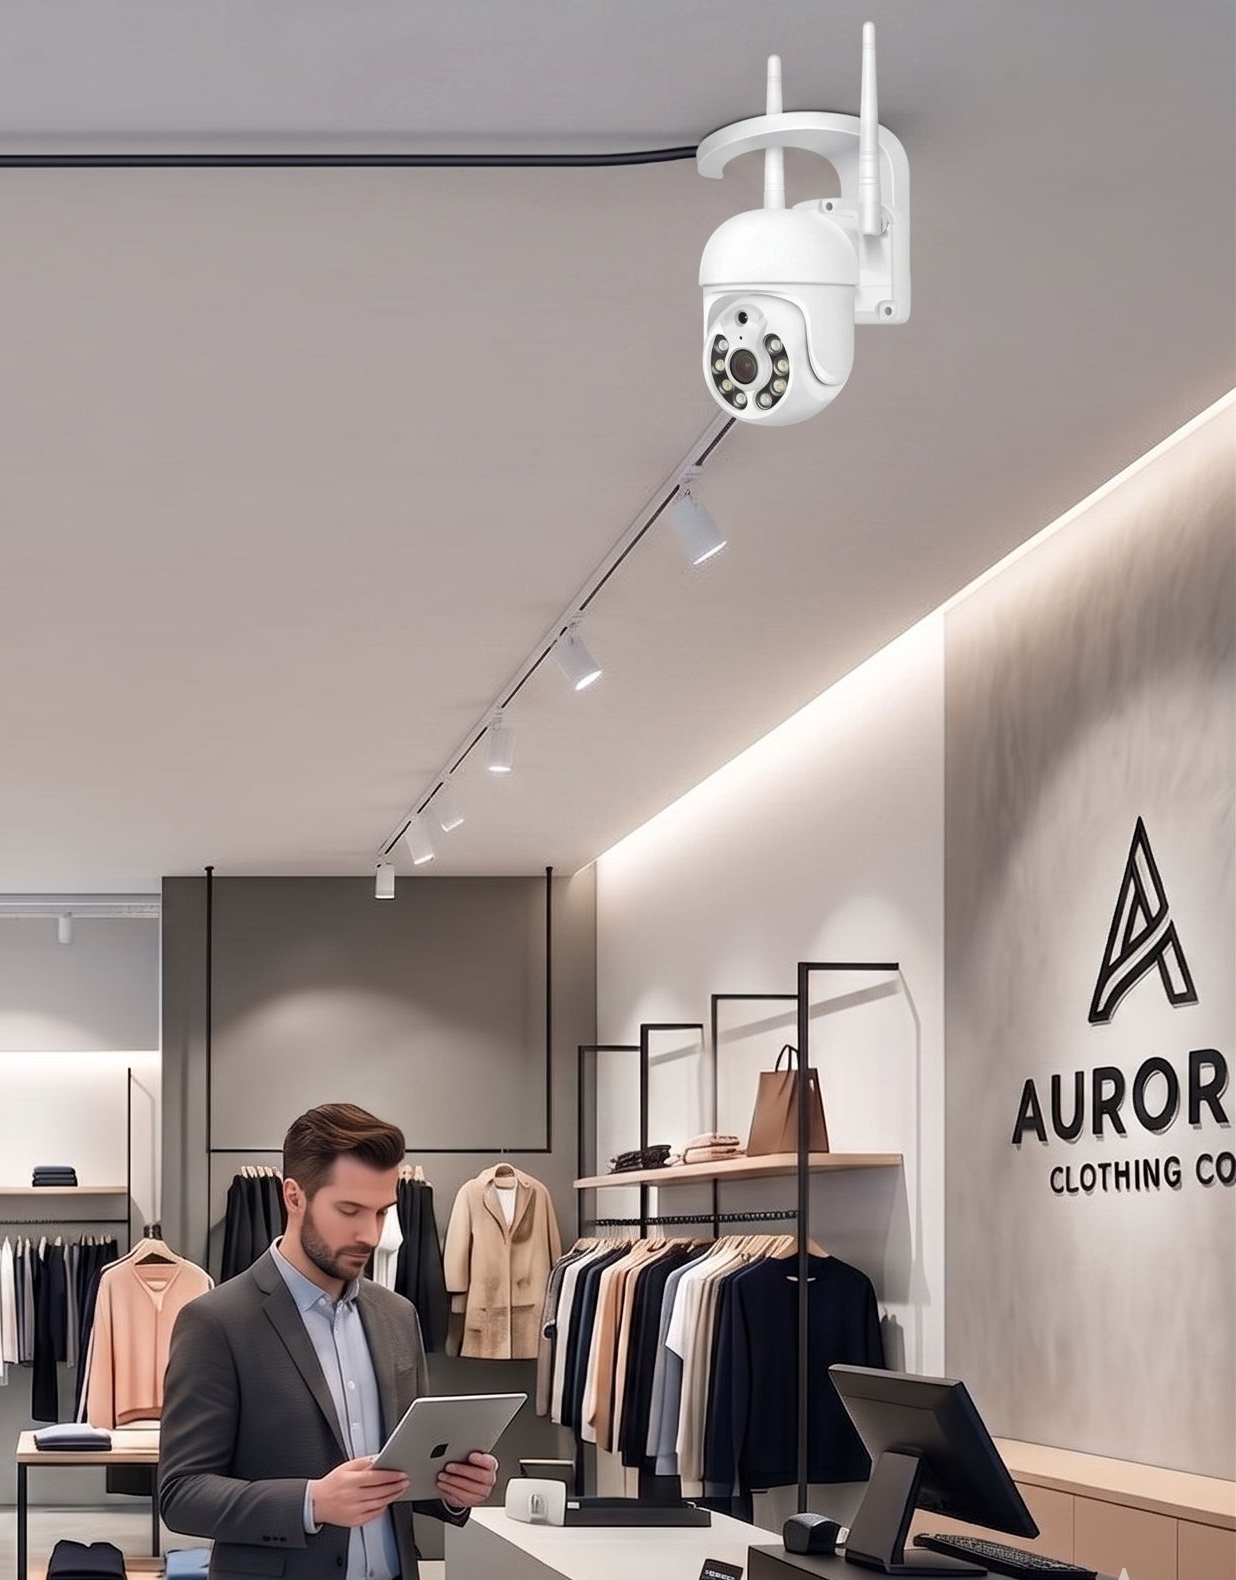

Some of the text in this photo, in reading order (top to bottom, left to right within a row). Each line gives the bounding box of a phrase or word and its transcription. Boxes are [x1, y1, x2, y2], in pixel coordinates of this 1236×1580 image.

[1011, 1048, 1231, 1144] AUROR
[1050, 1151, 1236, 1194] CLOTHING CO
